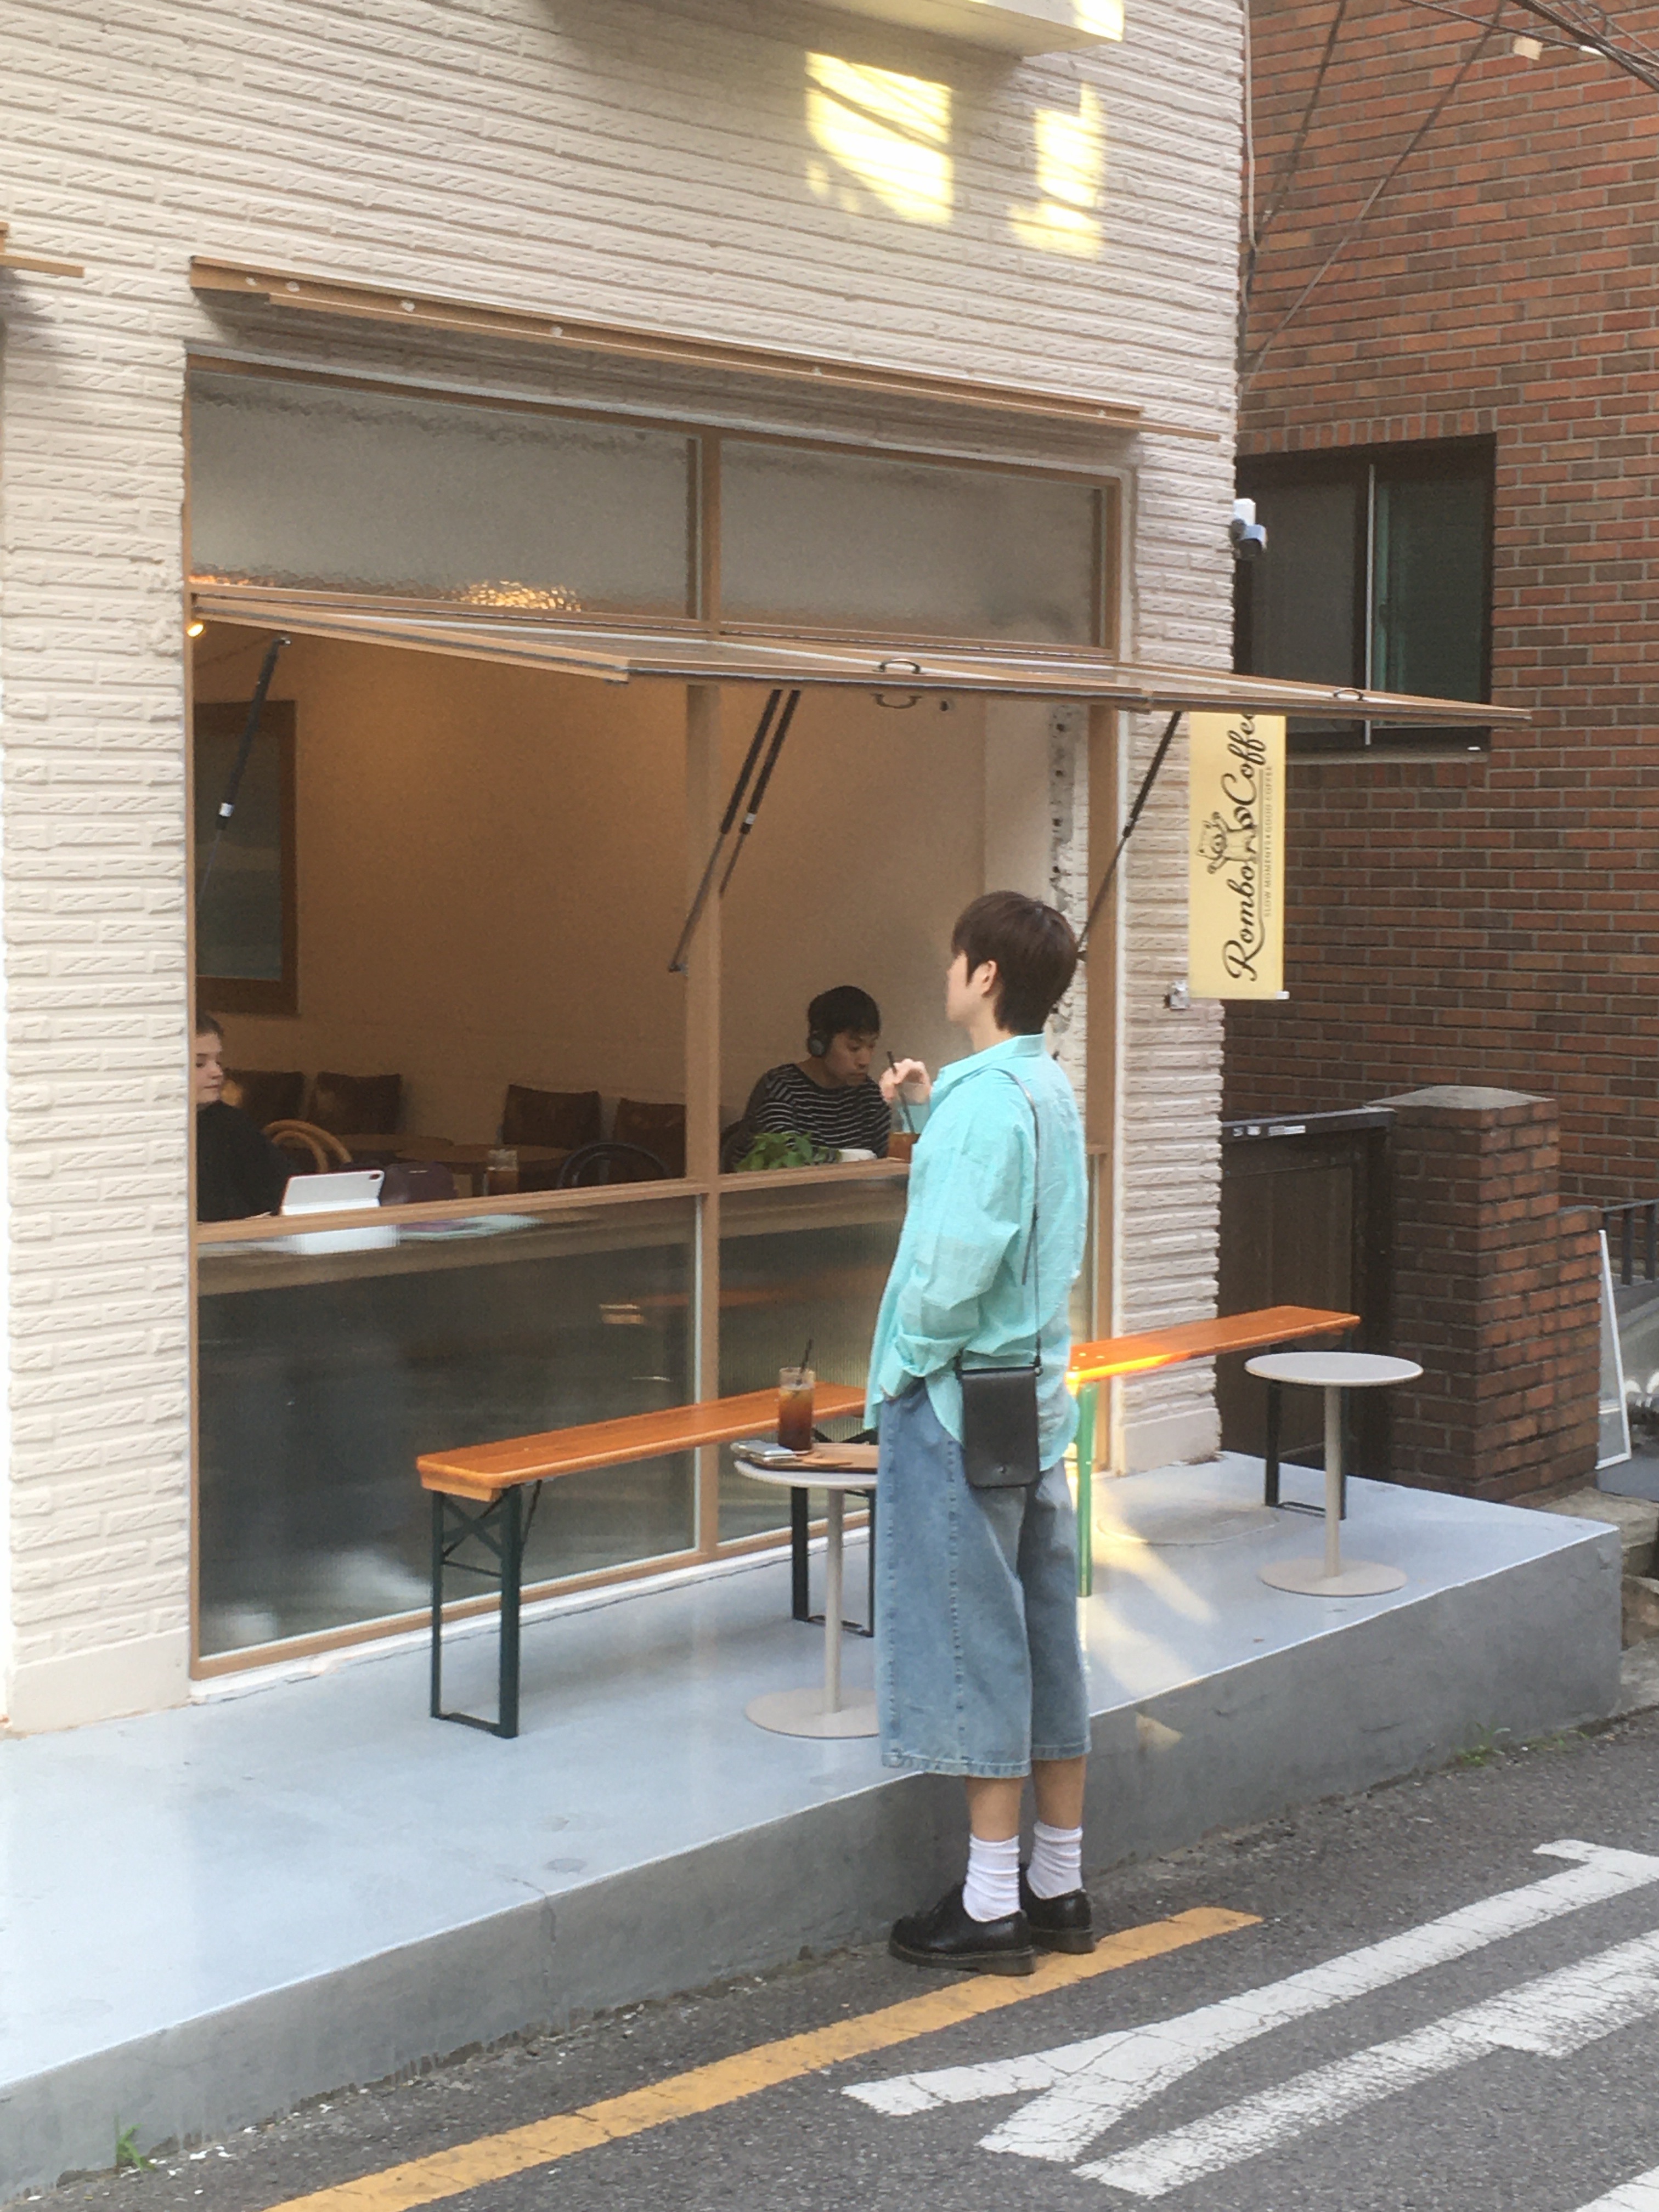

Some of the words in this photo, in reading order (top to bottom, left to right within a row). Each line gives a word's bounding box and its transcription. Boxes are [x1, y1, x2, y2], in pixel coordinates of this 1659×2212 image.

[1264, 766, 1273, 801] COFFEE
[1264, 804, 1272, 833] GOOD
[1263, 891, 1272, 917] SLOW
[1222, 864, 1263, 981] Rombo
